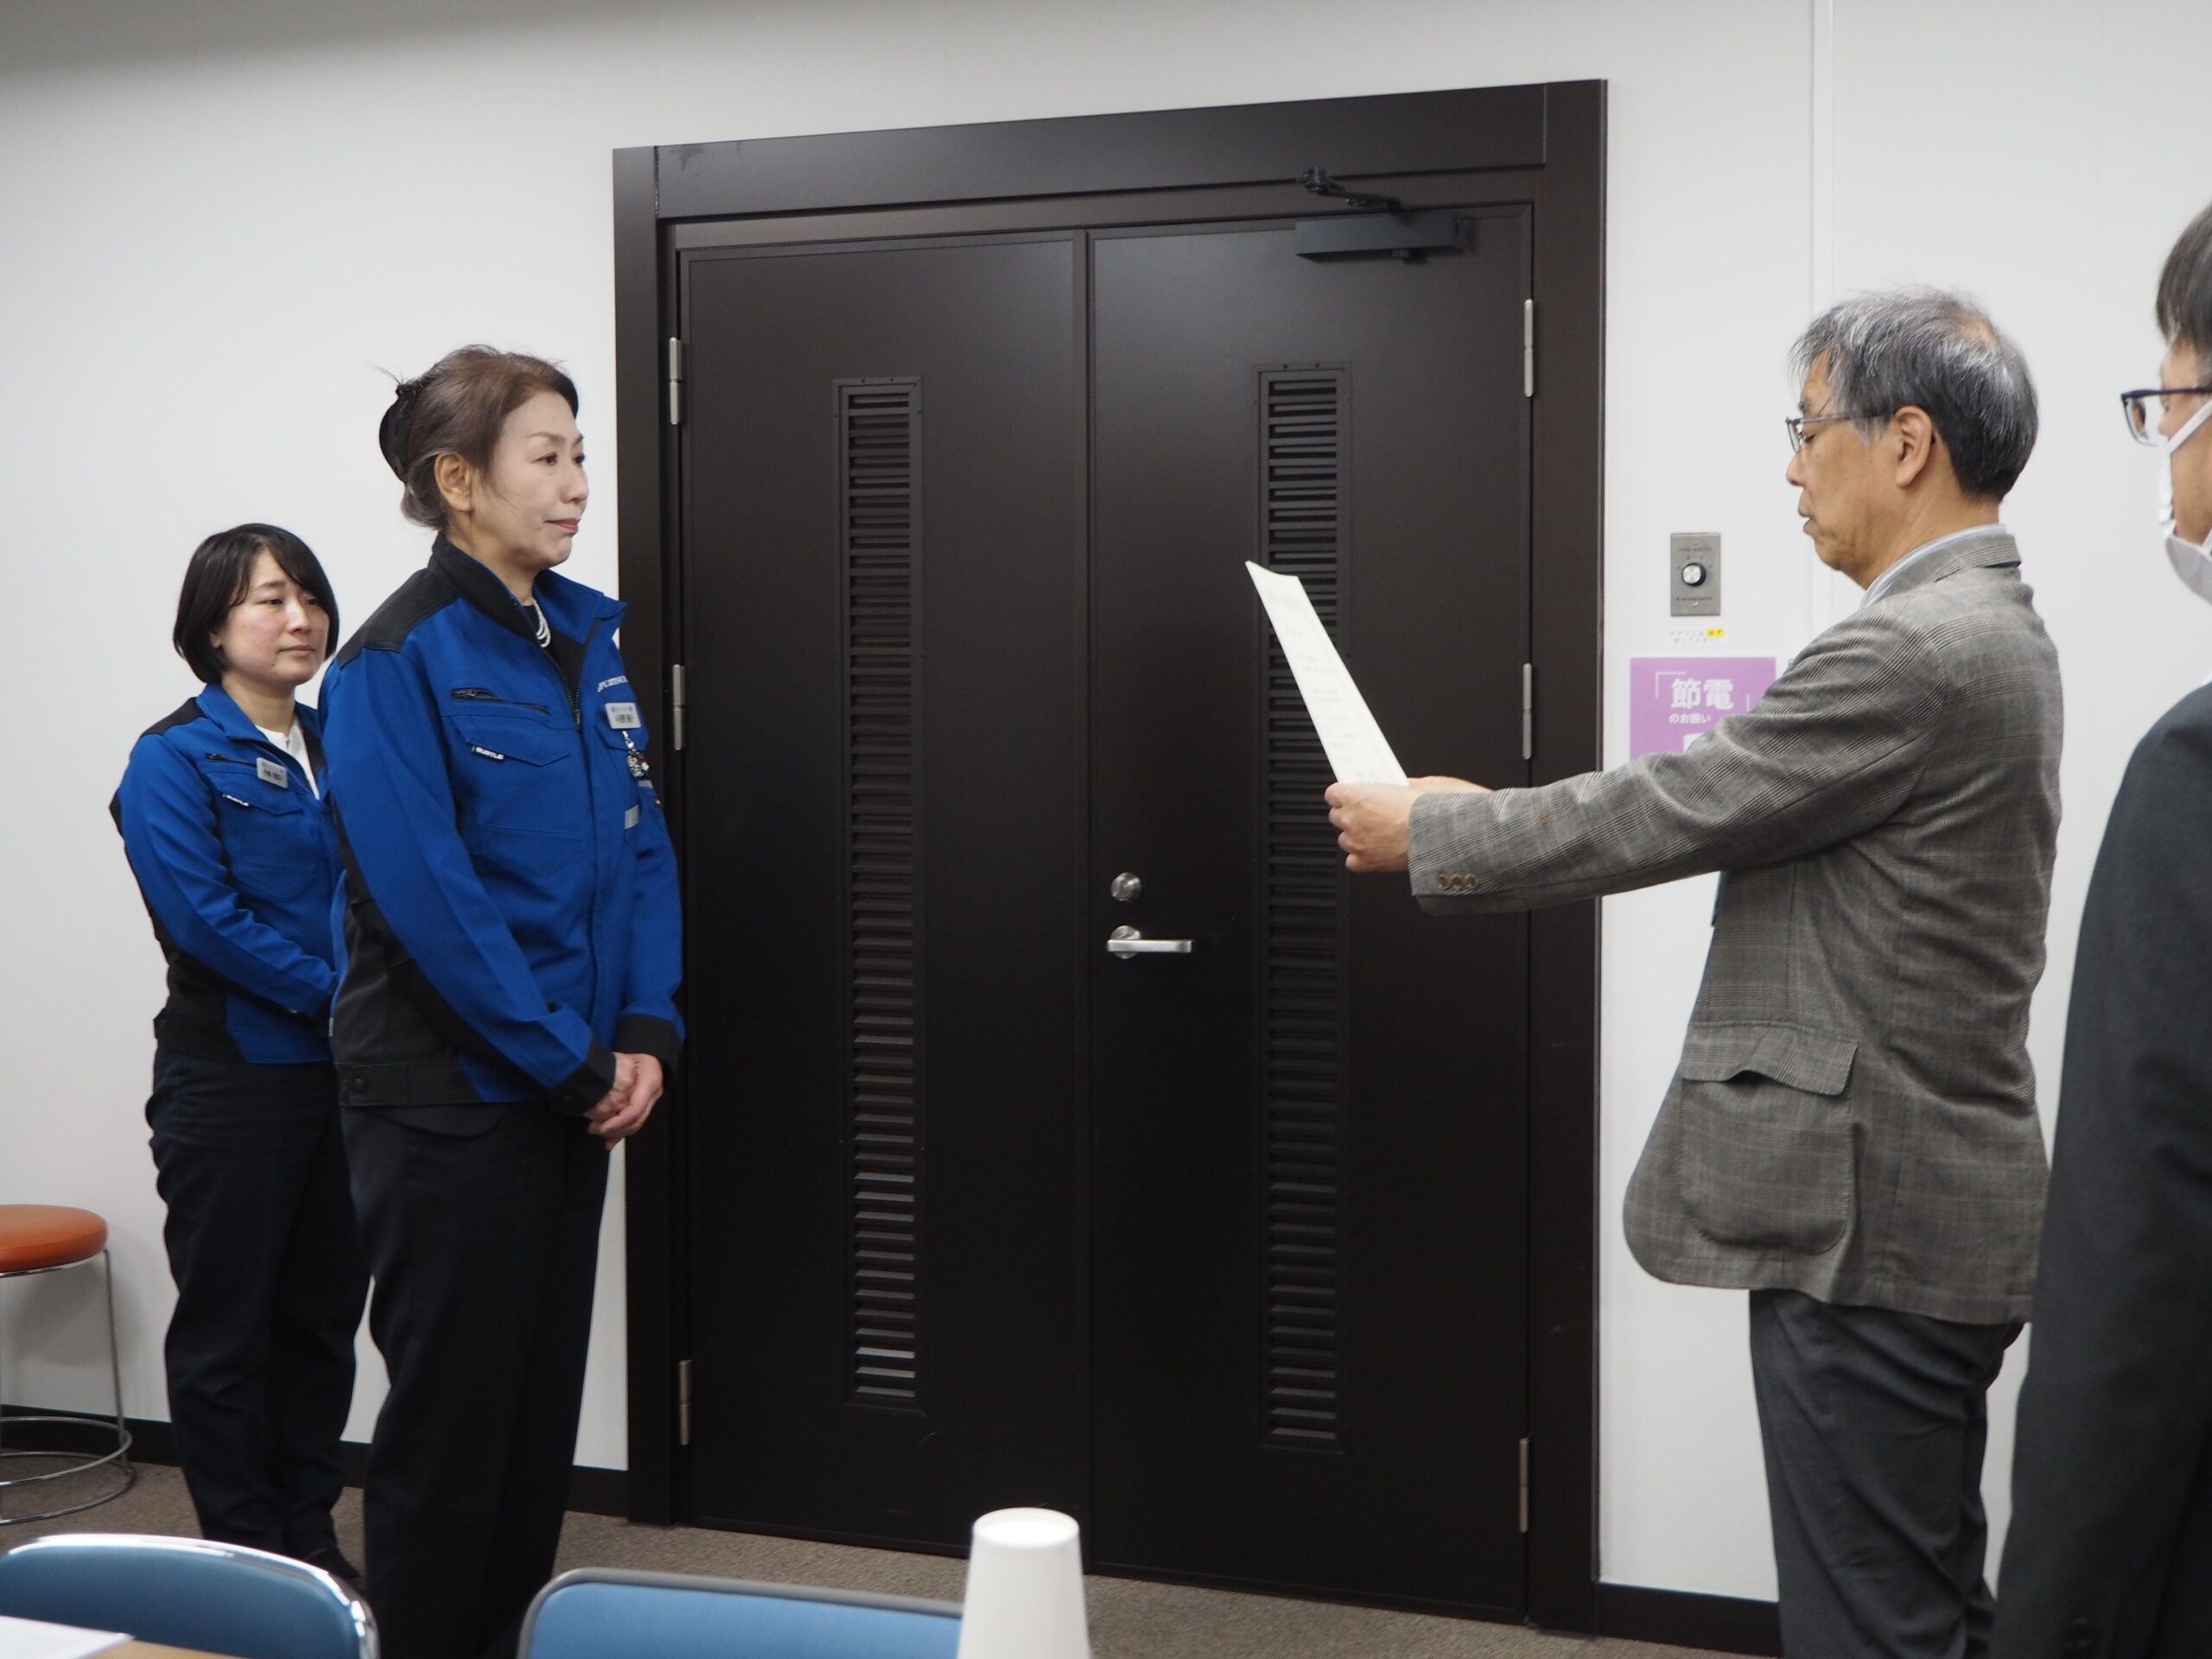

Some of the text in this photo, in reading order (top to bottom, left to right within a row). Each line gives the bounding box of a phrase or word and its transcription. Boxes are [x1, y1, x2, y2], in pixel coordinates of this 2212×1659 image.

[1671, 678, 1733, 709] 節電
[1669, 713, 1711, 724] のお願い
